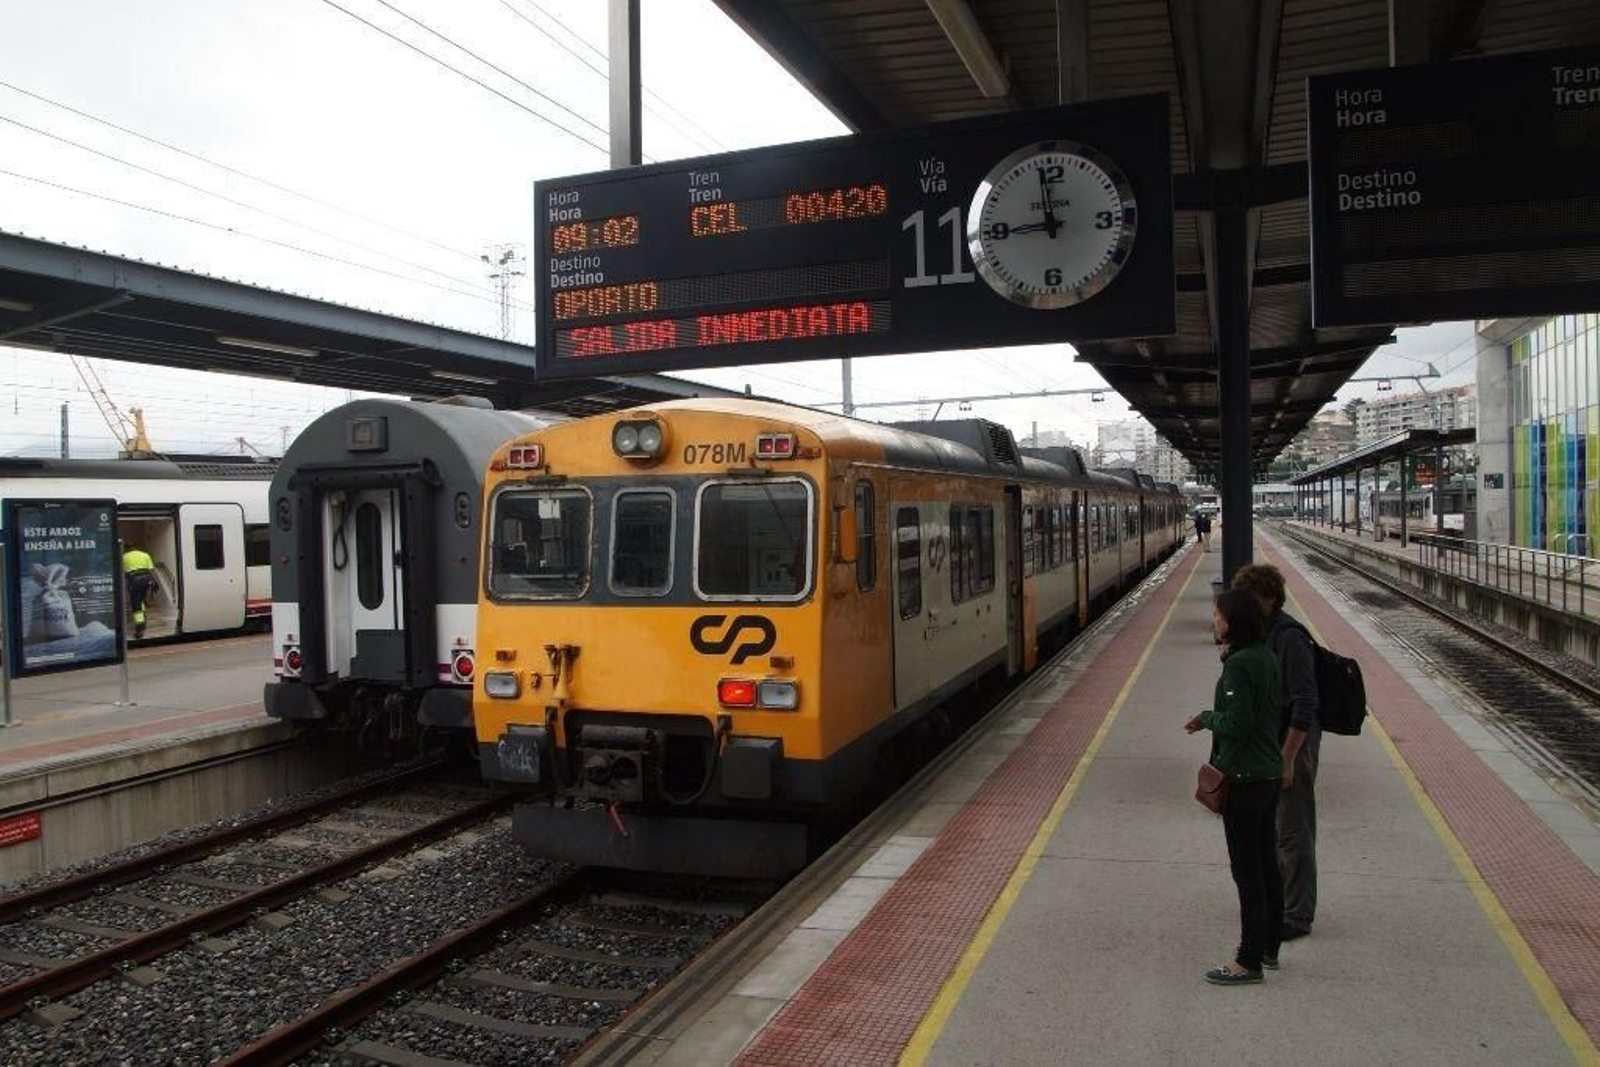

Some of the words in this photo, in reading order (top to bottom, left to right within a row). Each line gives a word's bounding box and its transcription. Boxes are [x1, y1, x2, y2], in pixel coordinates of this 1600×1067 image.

[1552, 65, 1599, 85] Tren
[1335, 87, 1383, 107] Hora
[1552, 86, 1600, 105] Tren
[1336, 109, 1387, 128] Hora
[919, 157, 945, 176] Vía
[688, 171, 720, 187] Tren
[920, 175, 948, 195] Vía
[1337, 169, 1417, 191] Destino
[548, 189, 580, 207] Hora
[688, 187, 722, 204] Tren
[1338, 189, 1422, 211] Destino
[549, 206, 582, 222] Hora
[691, 202, 748, 237] CEL
[786, 184, 887, 224] 00420
[1095, 211, 1113, 229] 3
[553, 215, 639, 254] 09:02
[991, 222, 1009, 240] 9
[901, 206, 976, 288] 11
[550, 254, 601, 273] Destino
[550, 270, 604, 289] Destino
[1044, 268, 1062, 287] 6
[554, 280, 658, 320] OPORTO
[570, 319, 676, 357] SALIDA
[696, 302, 870, 346] INMEDIATA
[684, 442, 746, 465] 078M
[24, 527, 47, 538] ESTE
[49, 527, 82, 537] ARROZ
[24, 539, 64, 551] ENSEÑA
[74, 540, 97, 550] LEER
